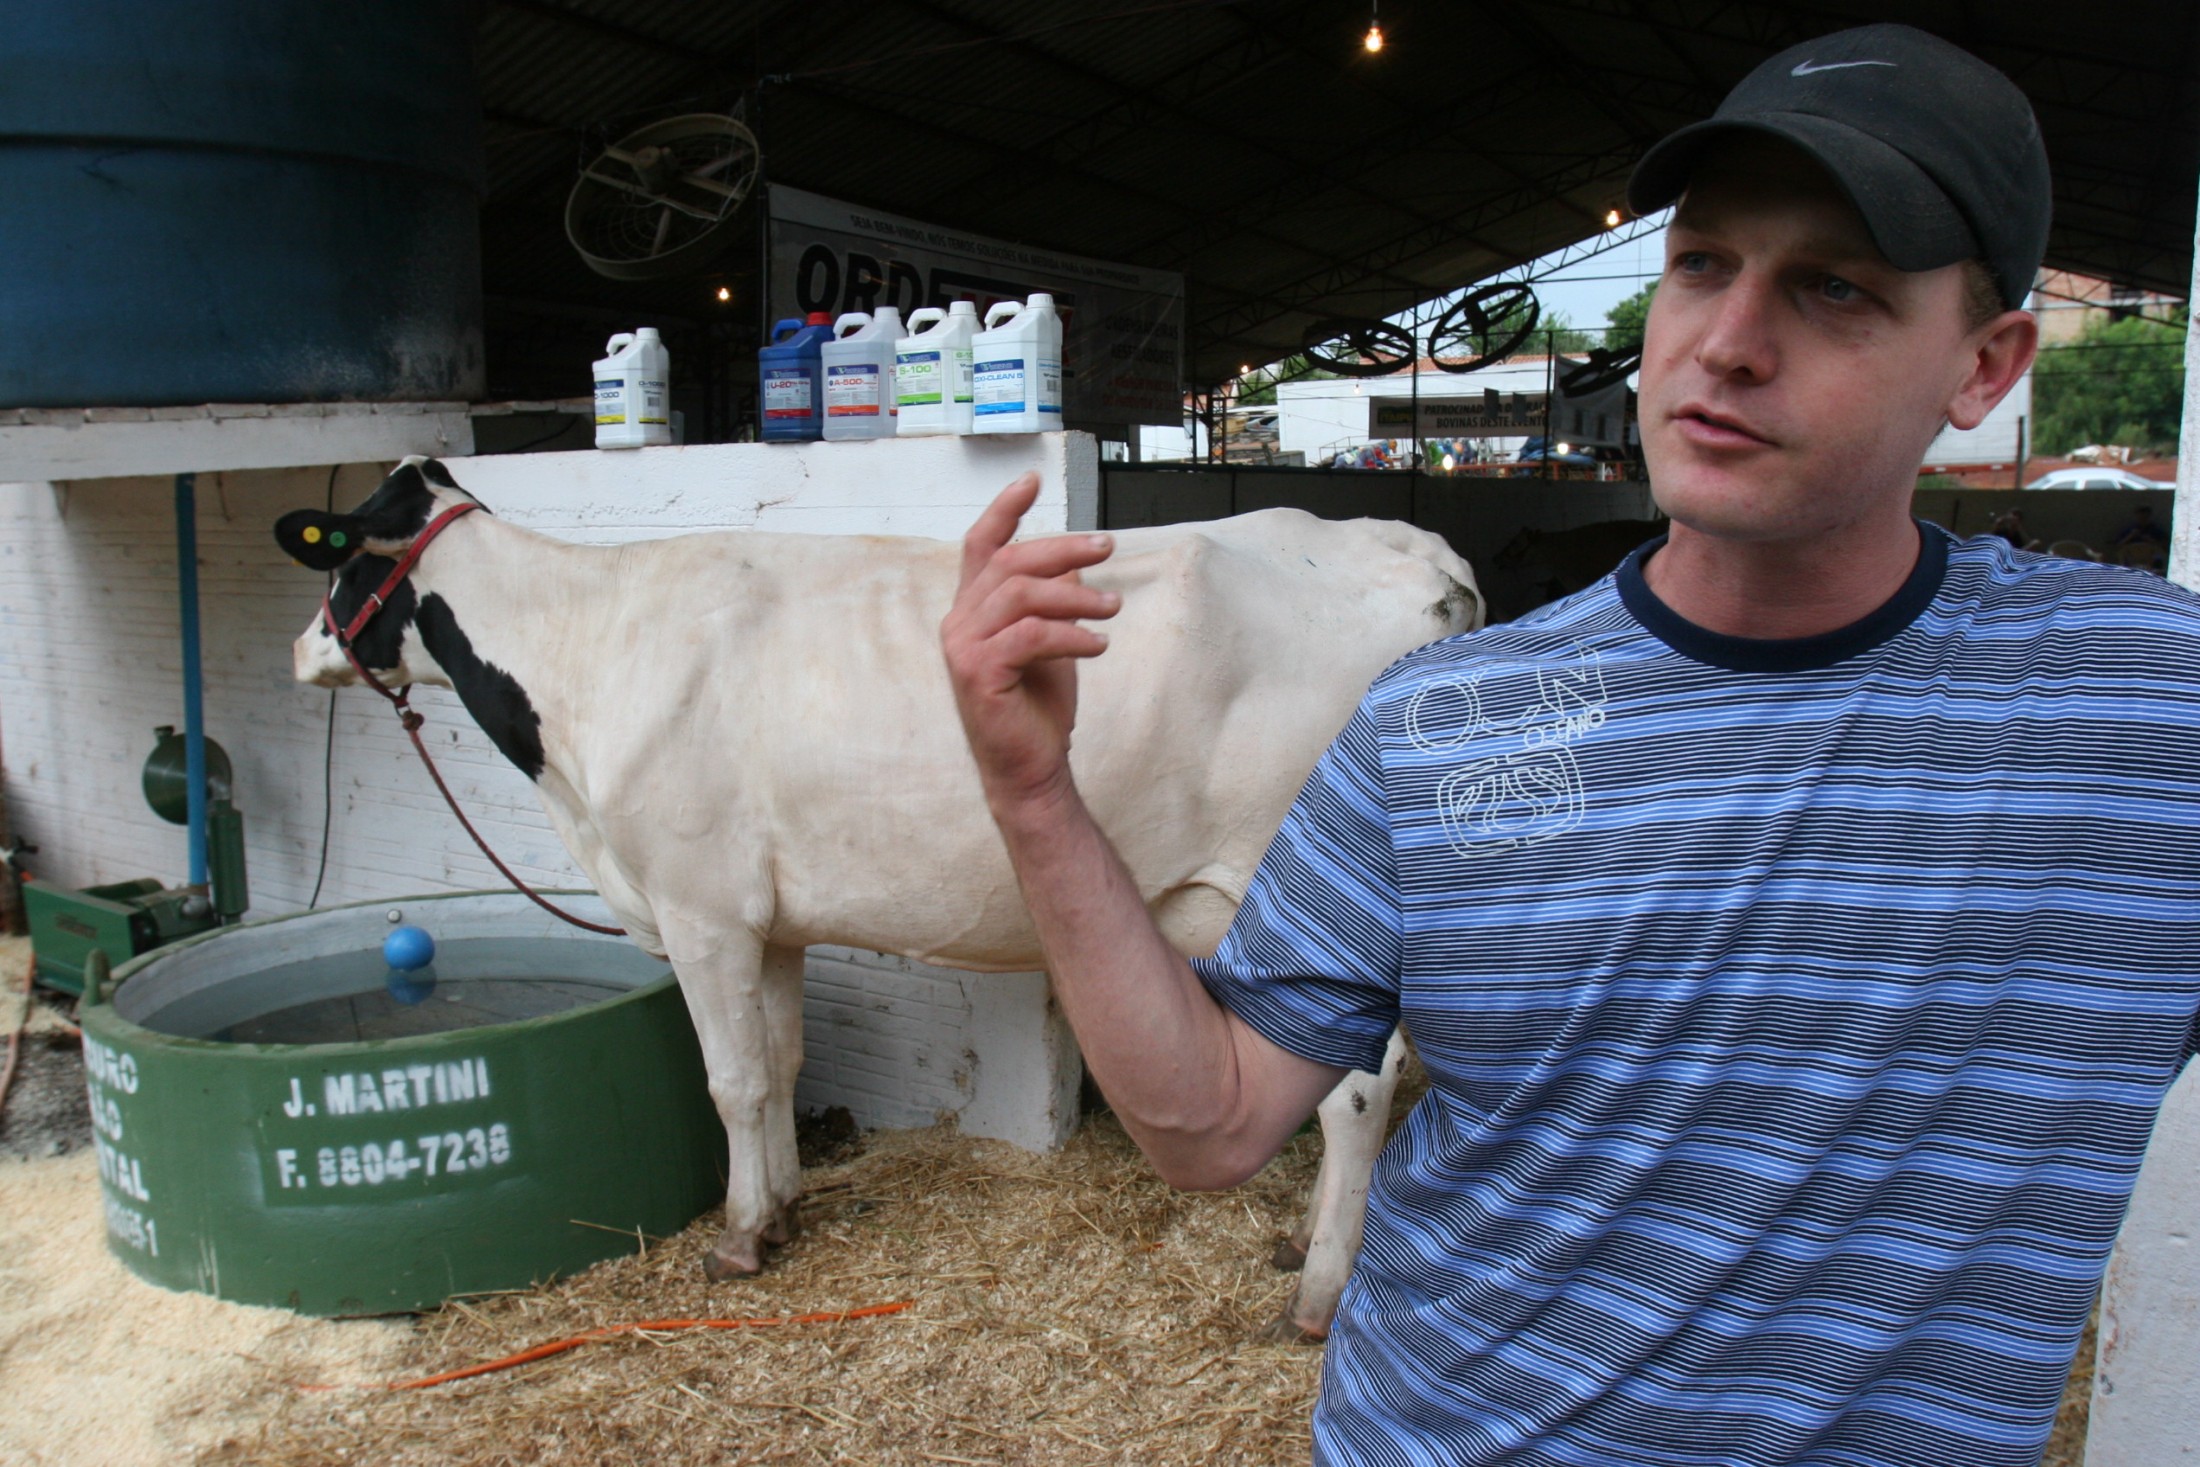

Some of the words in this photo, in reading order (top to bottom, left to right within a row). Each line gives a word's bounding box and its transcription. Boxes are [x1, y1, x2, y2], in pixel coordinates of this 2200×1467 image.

[947, 237, 975, 253] TEMOS
[899, 364, 932, 376] S-100
[834, 378, 863, 386] A-500
[1436, 417, 1478, 429] BOVINAS
[1480, 415, 1510, 428] DESTE
[1523, 705, 1606, 750] OCEANO
[283, 1077, 317, 1119] J.
[325, 1056, 490, 1116] MARTINI
[276, 1149, 307, 1189] F.
[318, 1123, 511, 1188] 8804-7238
